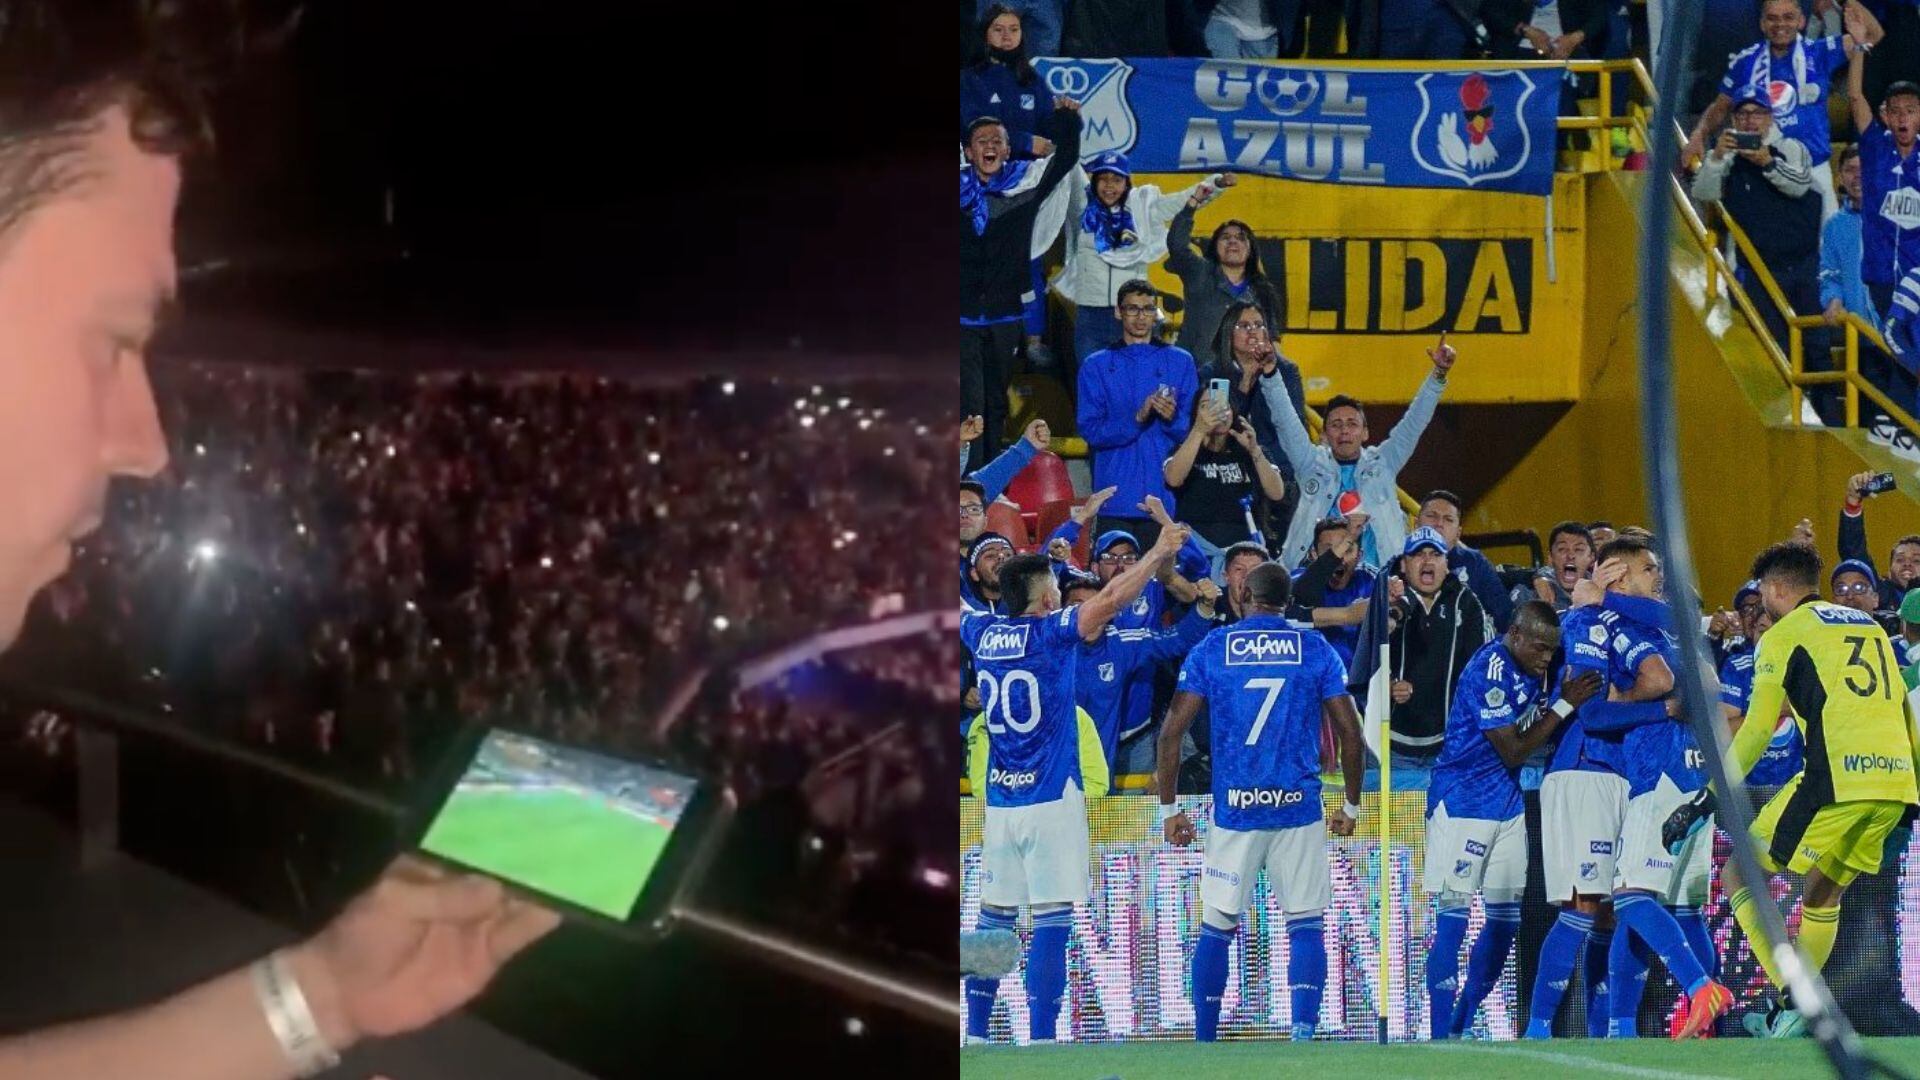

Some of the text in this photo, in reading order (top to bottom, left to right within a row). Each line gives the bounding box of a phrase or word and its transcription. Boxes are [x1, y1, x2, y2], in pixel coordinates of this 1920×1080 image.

[1178, 117, 1386, 184] AZUL
[1844, 635, 1892, 700] 31
[977, 669, 1042, 733] 20
[1244, 678, 1286, 745] 7
[1228, 788, 1302, 809] Wplay.co
